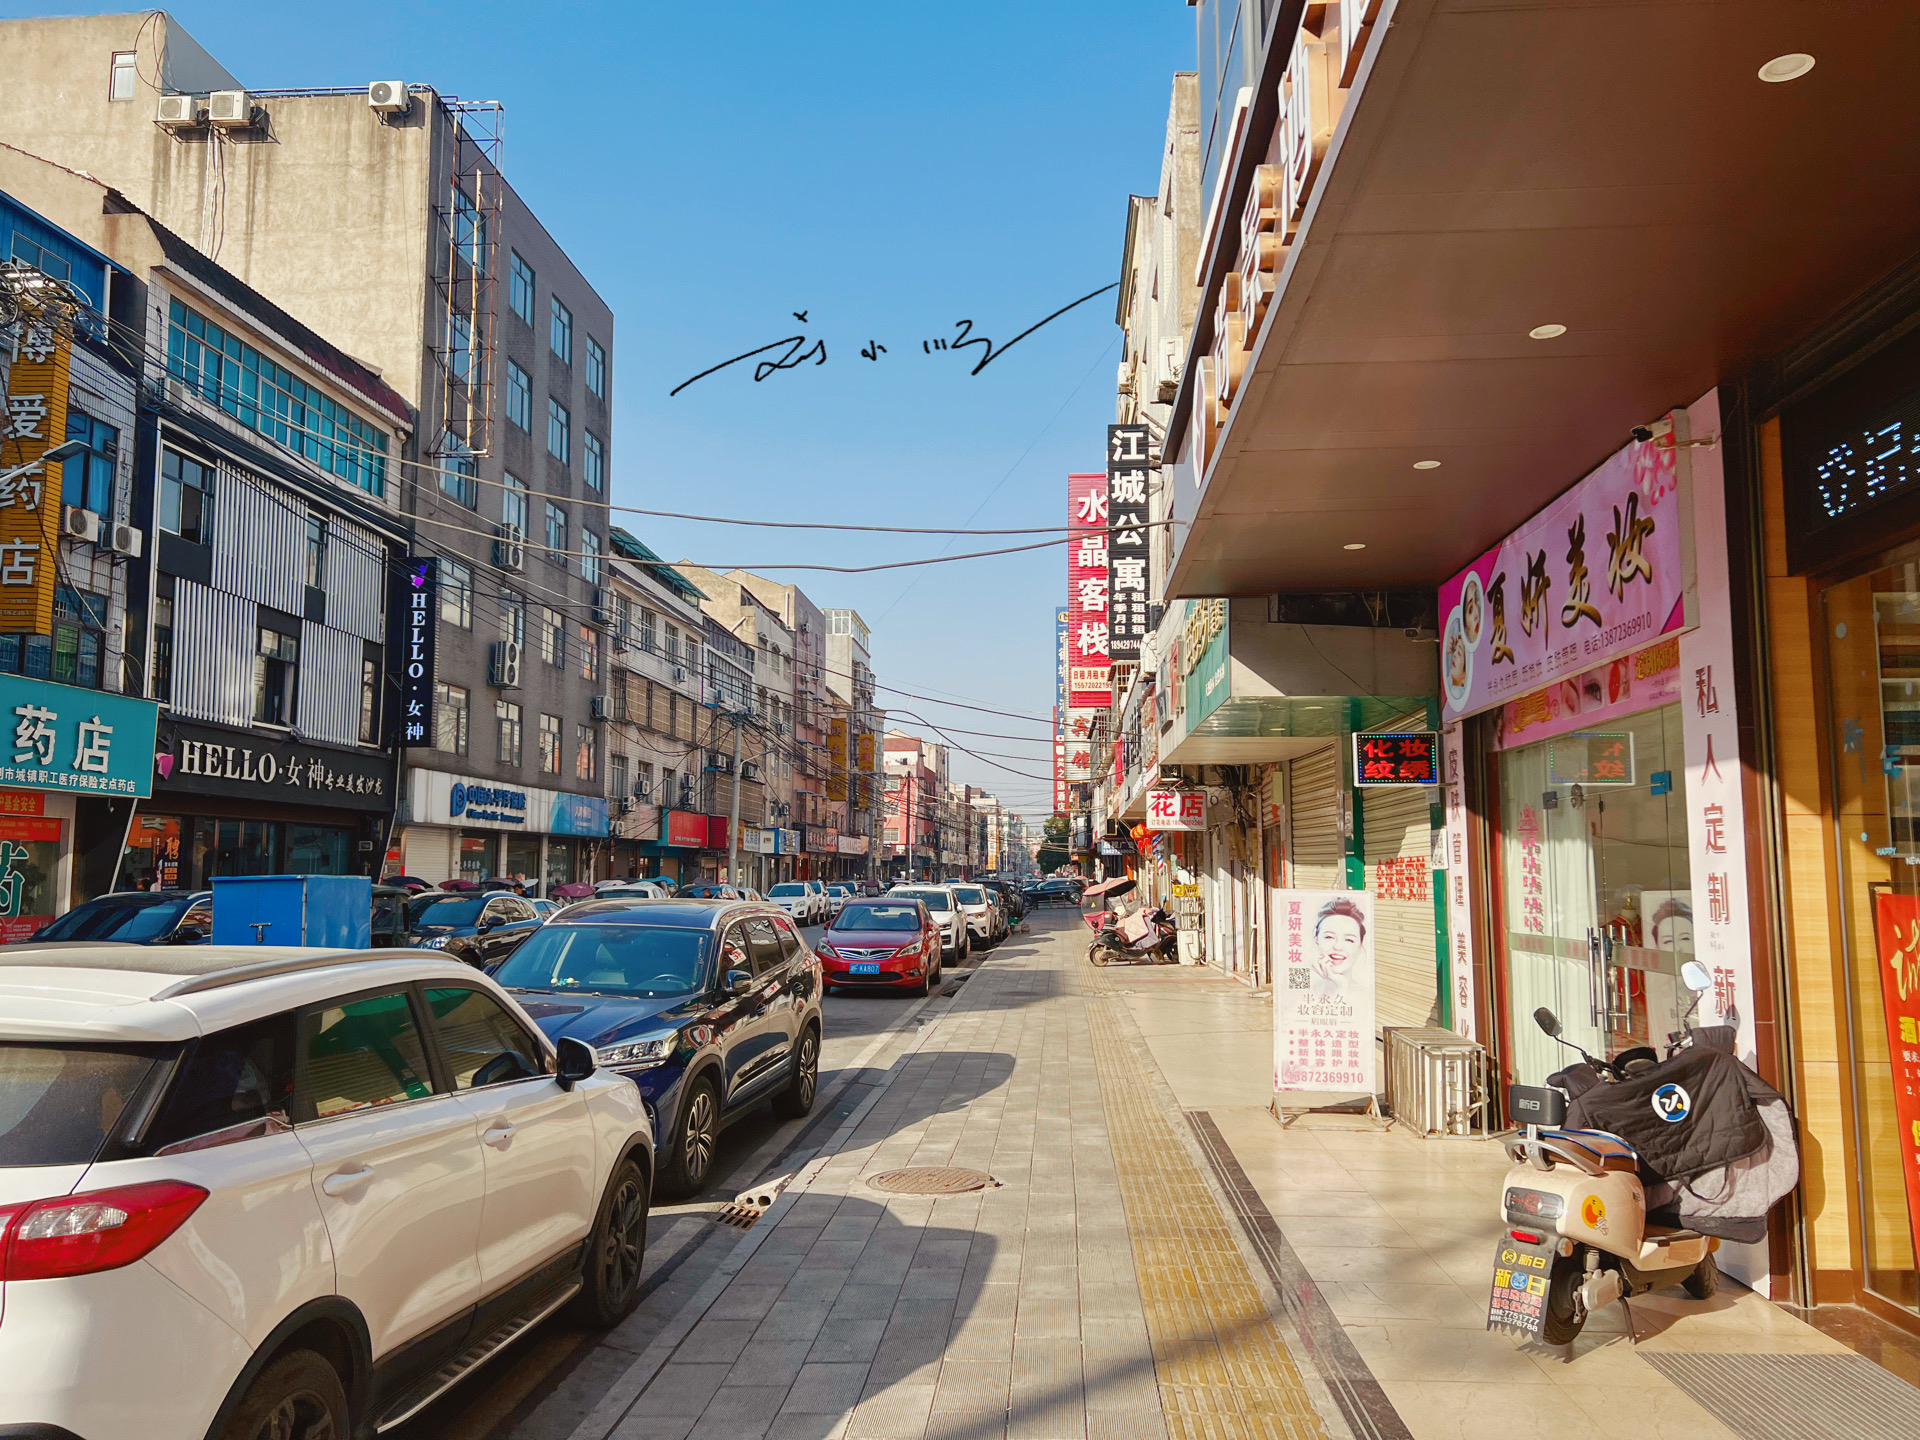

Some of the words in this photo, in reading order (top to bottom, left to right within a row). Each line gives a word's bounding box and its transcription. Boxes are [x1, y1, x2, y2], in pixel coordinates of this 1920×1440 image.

[1111, 430, 1147, 591] 江城公寓
[1077, 489, 1109, 656] 水晶客栈
[1073, 670, 1111, 680] 日租月租年
[14, 704, 113, 774] 药店
[1363, 739, 1430, 758] 化妆
[1363, 760, 1430, 779] 纹绣
[1695, 664, 1731, 926] 私人定制
[1151, 793, 1203, 817] 花店
[1876, 847, 1897, 856] HAPPY
[1288, 901, 1303, 963] 夏妍美妆
[1303, 993, 1347, 1005] 半永久
[1297, 1004, 1353, 1017] 妆容定制
[1298, 1028, 1359, 1039] 半永久定妆
[1298, 1038, 1359, 1049] 整体造型
[1298, 1048, 1359, 1059] 新娘跟妆
[1298, 1057, 1359, 1068] 美容护肤
[1519, 1098, 1540, 1111] 新日
[1518, 1253, 1547, 1270] 新日
